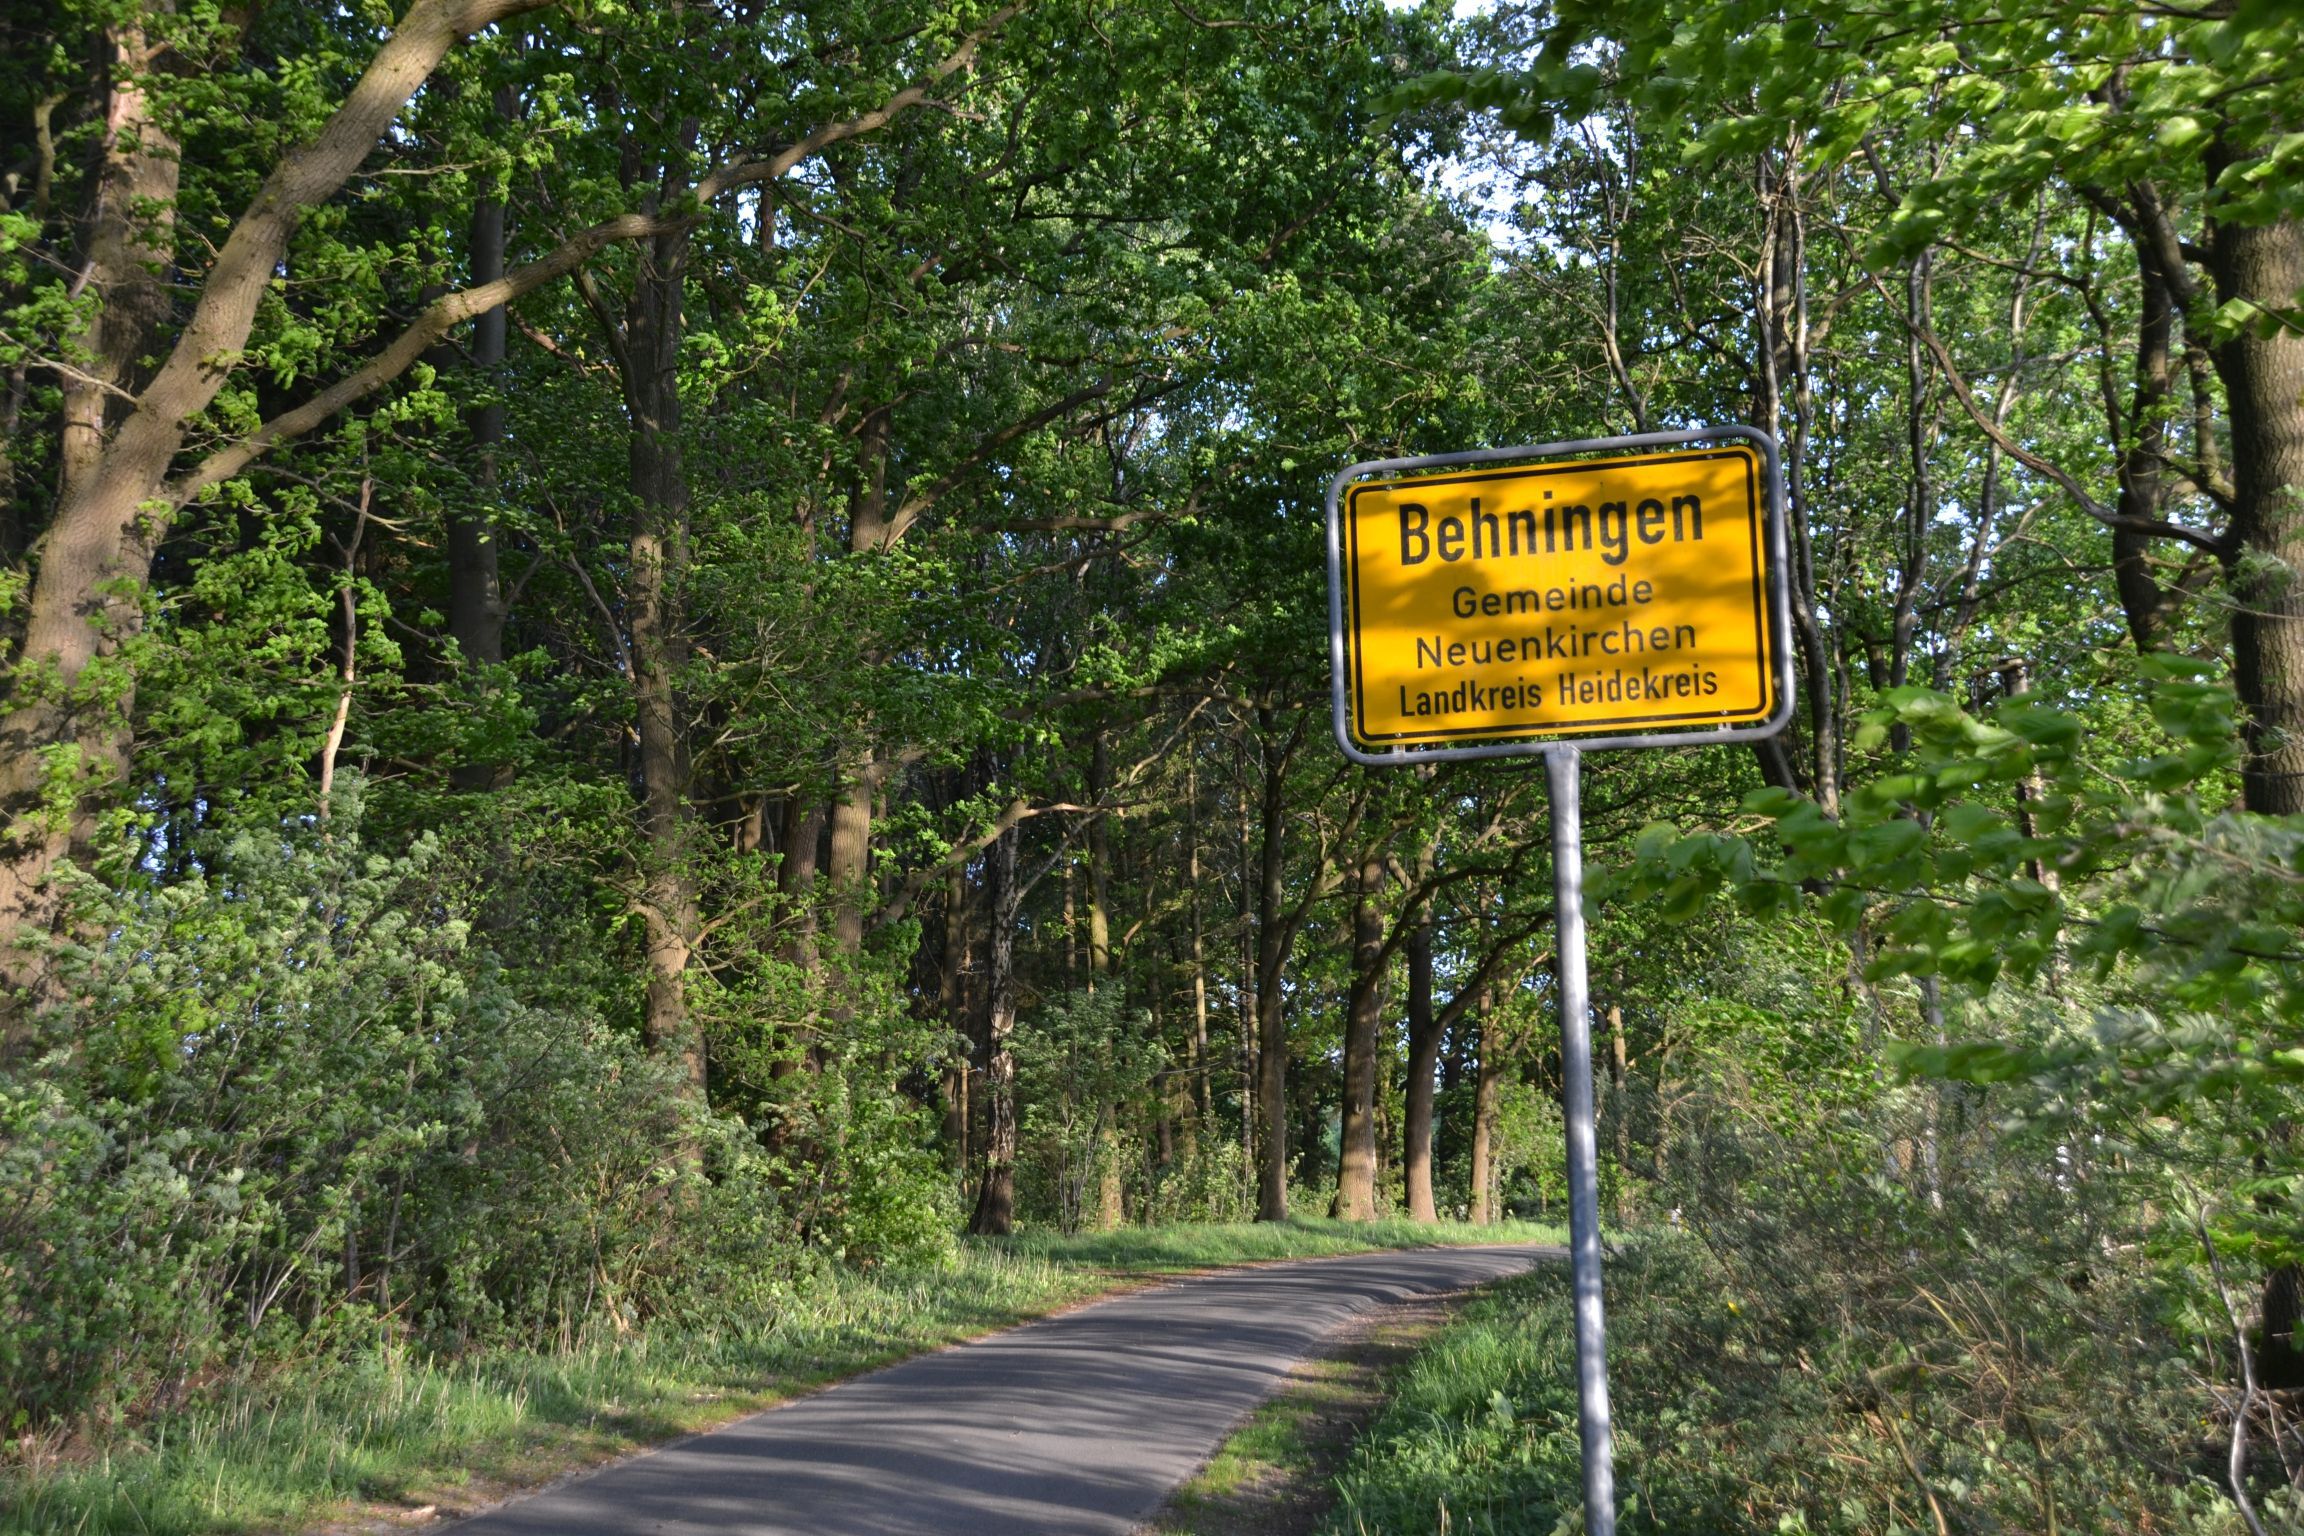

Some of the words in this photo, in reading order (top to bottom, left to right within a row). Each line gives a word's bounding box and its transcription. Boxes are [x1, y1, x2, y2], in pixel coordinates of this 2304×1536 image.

[1398, 491, 1703, 566] Behningen
[1452, 573, 1653, 619] Gemeinde
[1416, 622, 1697, 669] Neuenkirchen
[1400, 677, 1542, 717] Landkreis
[1558, 663, 1718, 706] Heidekreis
